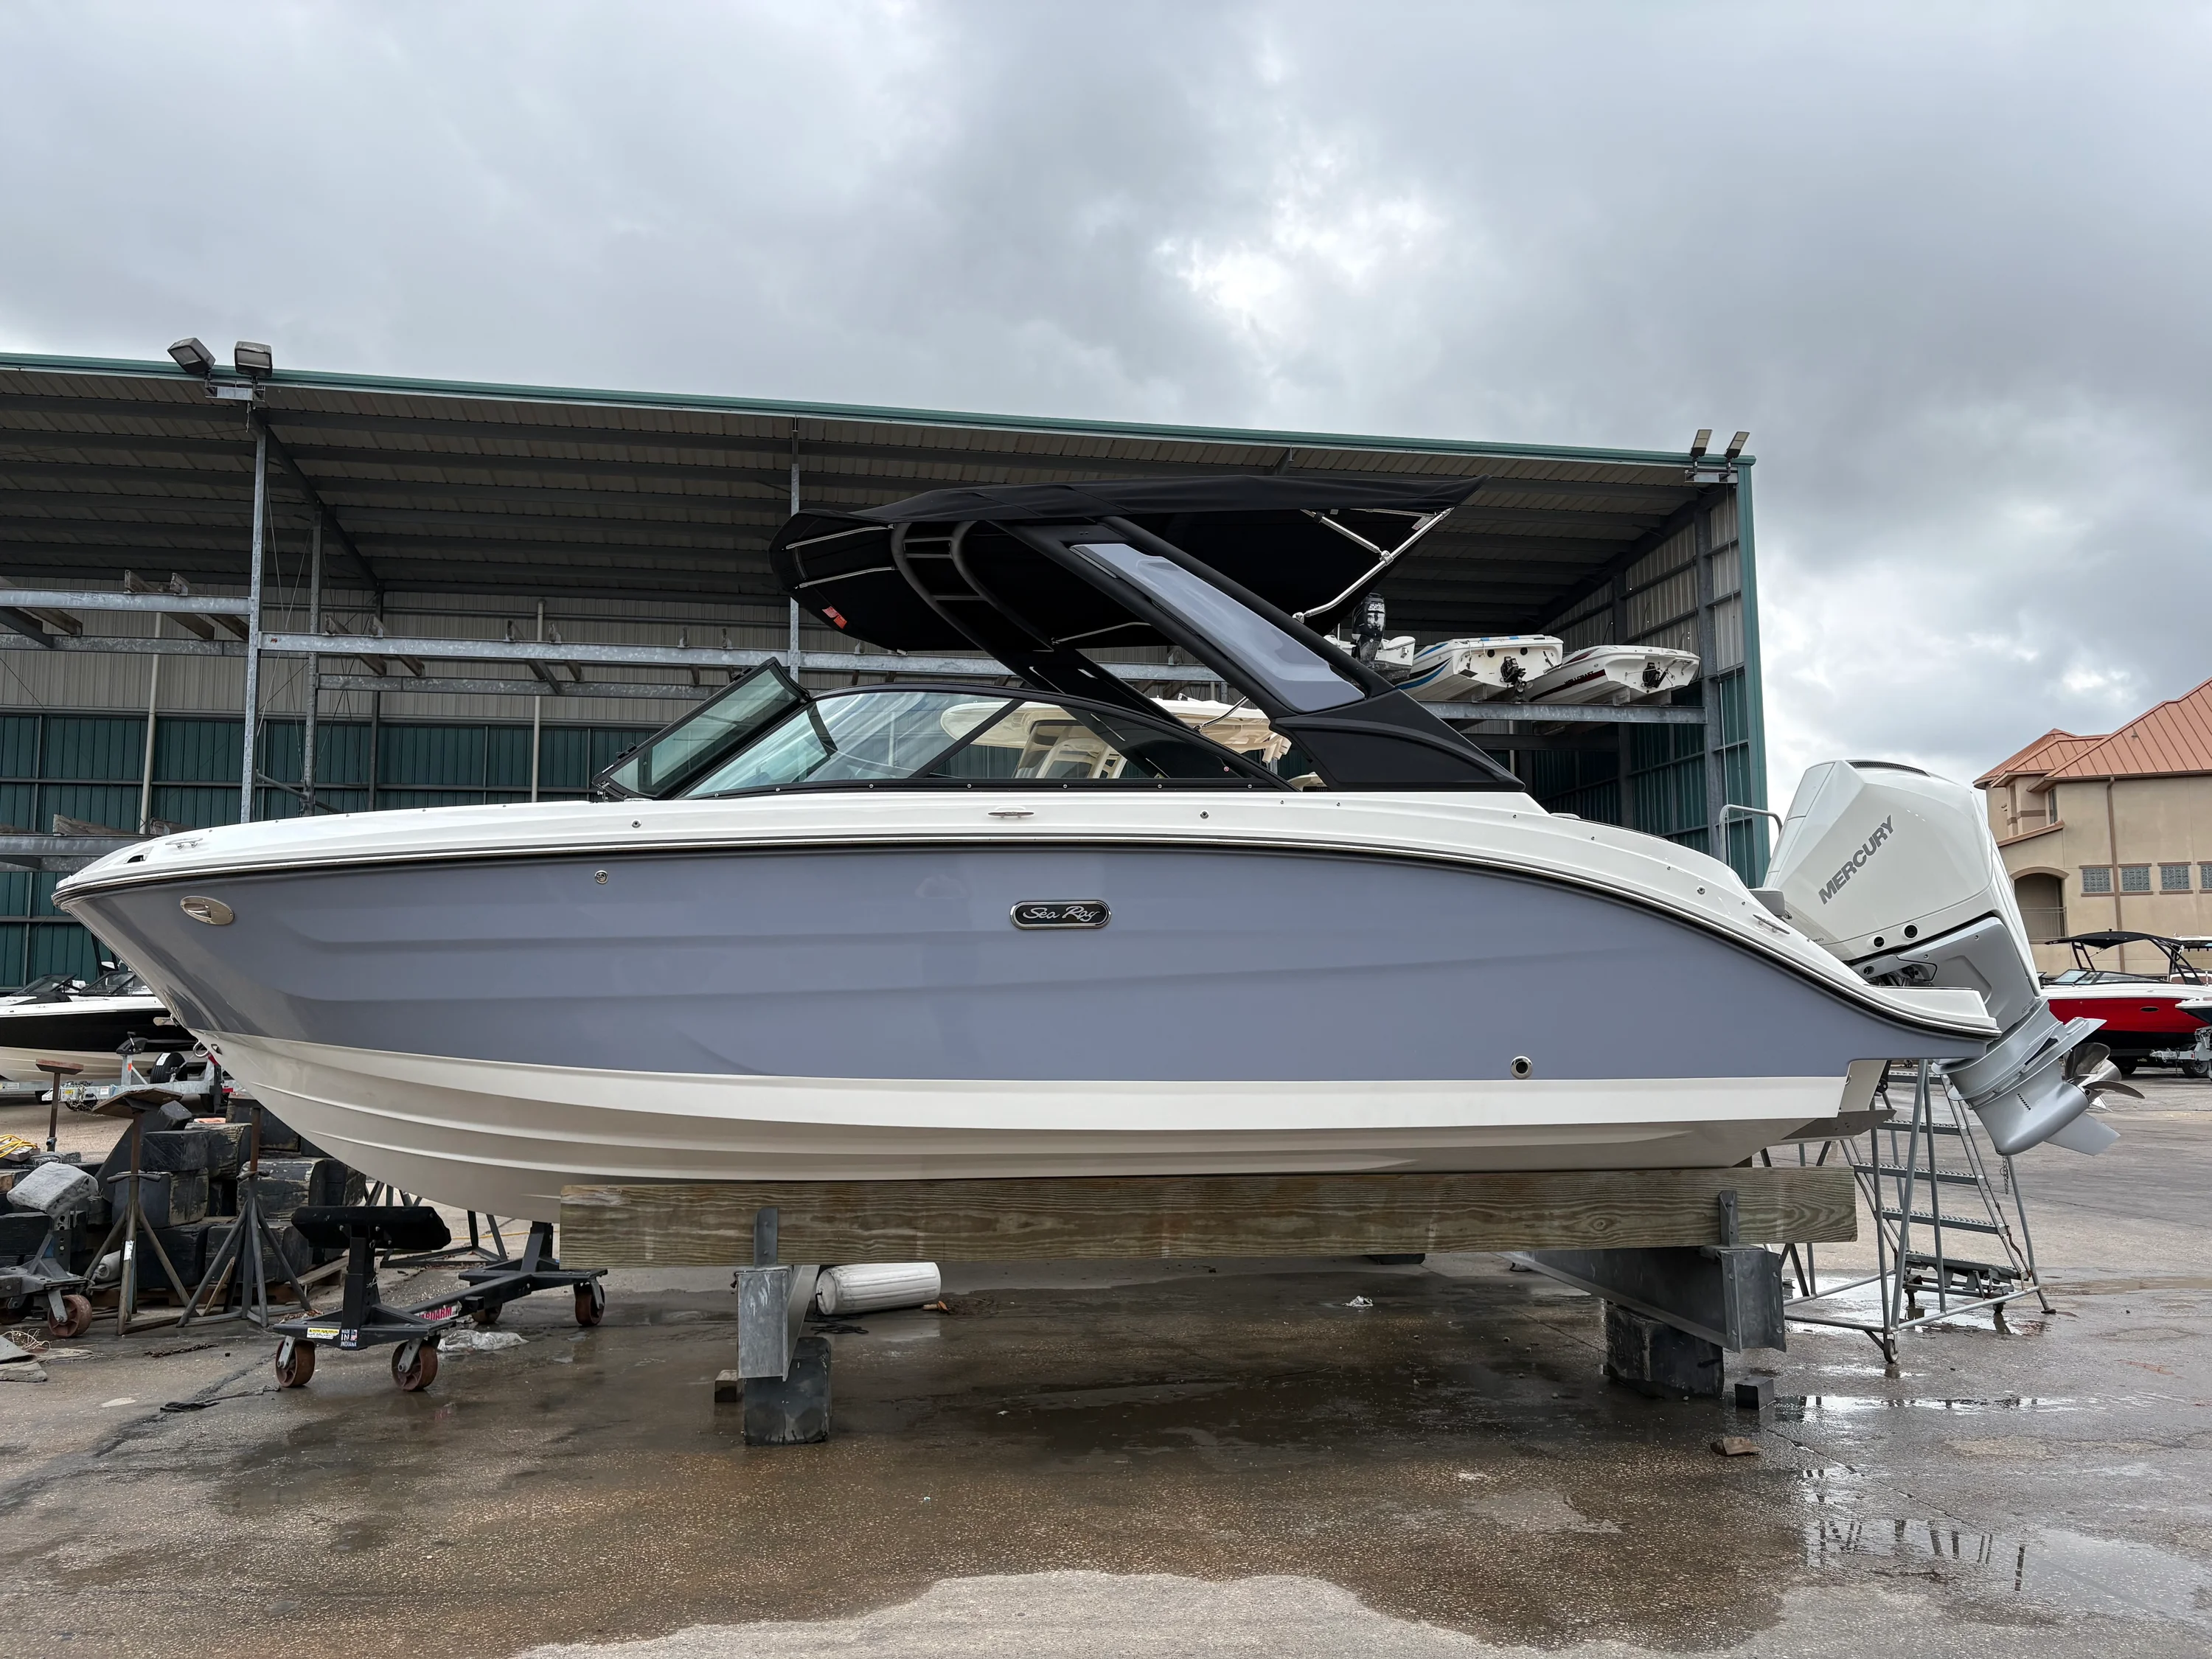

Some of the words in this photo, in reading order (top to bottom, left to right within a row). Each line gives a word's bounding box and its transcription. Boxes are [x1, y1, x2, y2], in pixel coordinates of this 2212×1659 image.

[1818, 815, 1893, 905] MERCURY
[1023, 908, 1060, 919] Sea
[1062, 905, 1100, 922] Ray
[419, 1306, 453, 1321] ARDARM
[341, 1333, 349, 1341] IN
